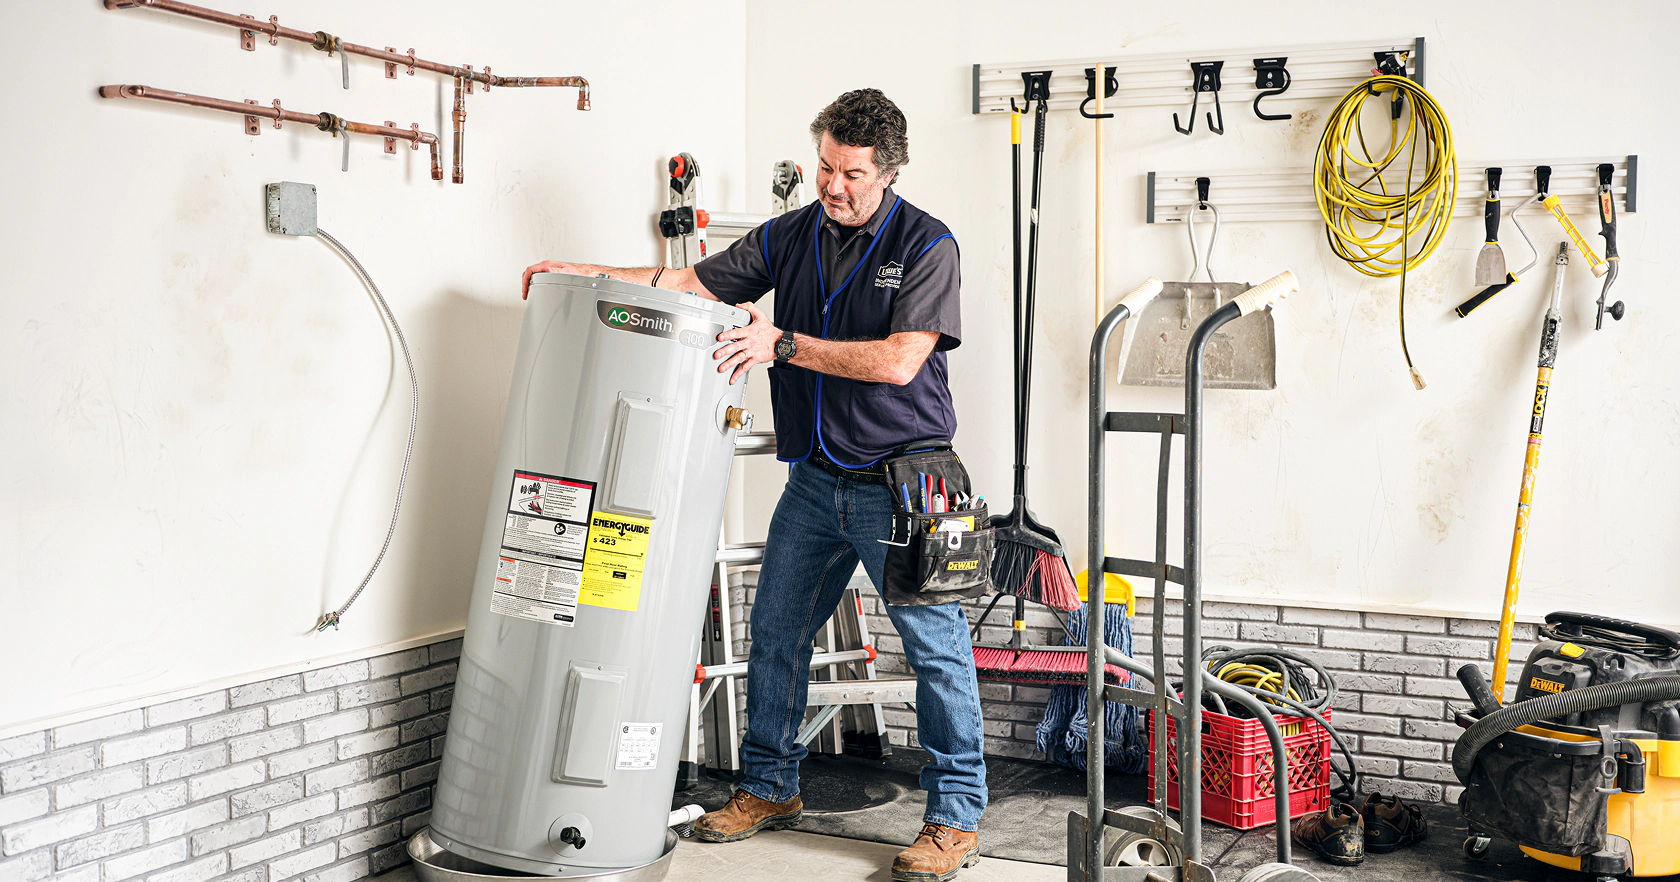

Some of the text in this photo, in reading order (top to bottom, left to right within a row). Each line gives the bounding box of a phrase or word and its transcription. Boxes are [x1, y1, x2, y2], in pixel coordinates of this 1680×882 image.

[686, 332, 705, 347] 100
[1532, 387, 1548, 418] LOCK
[599, 537, 616, 546] 423
